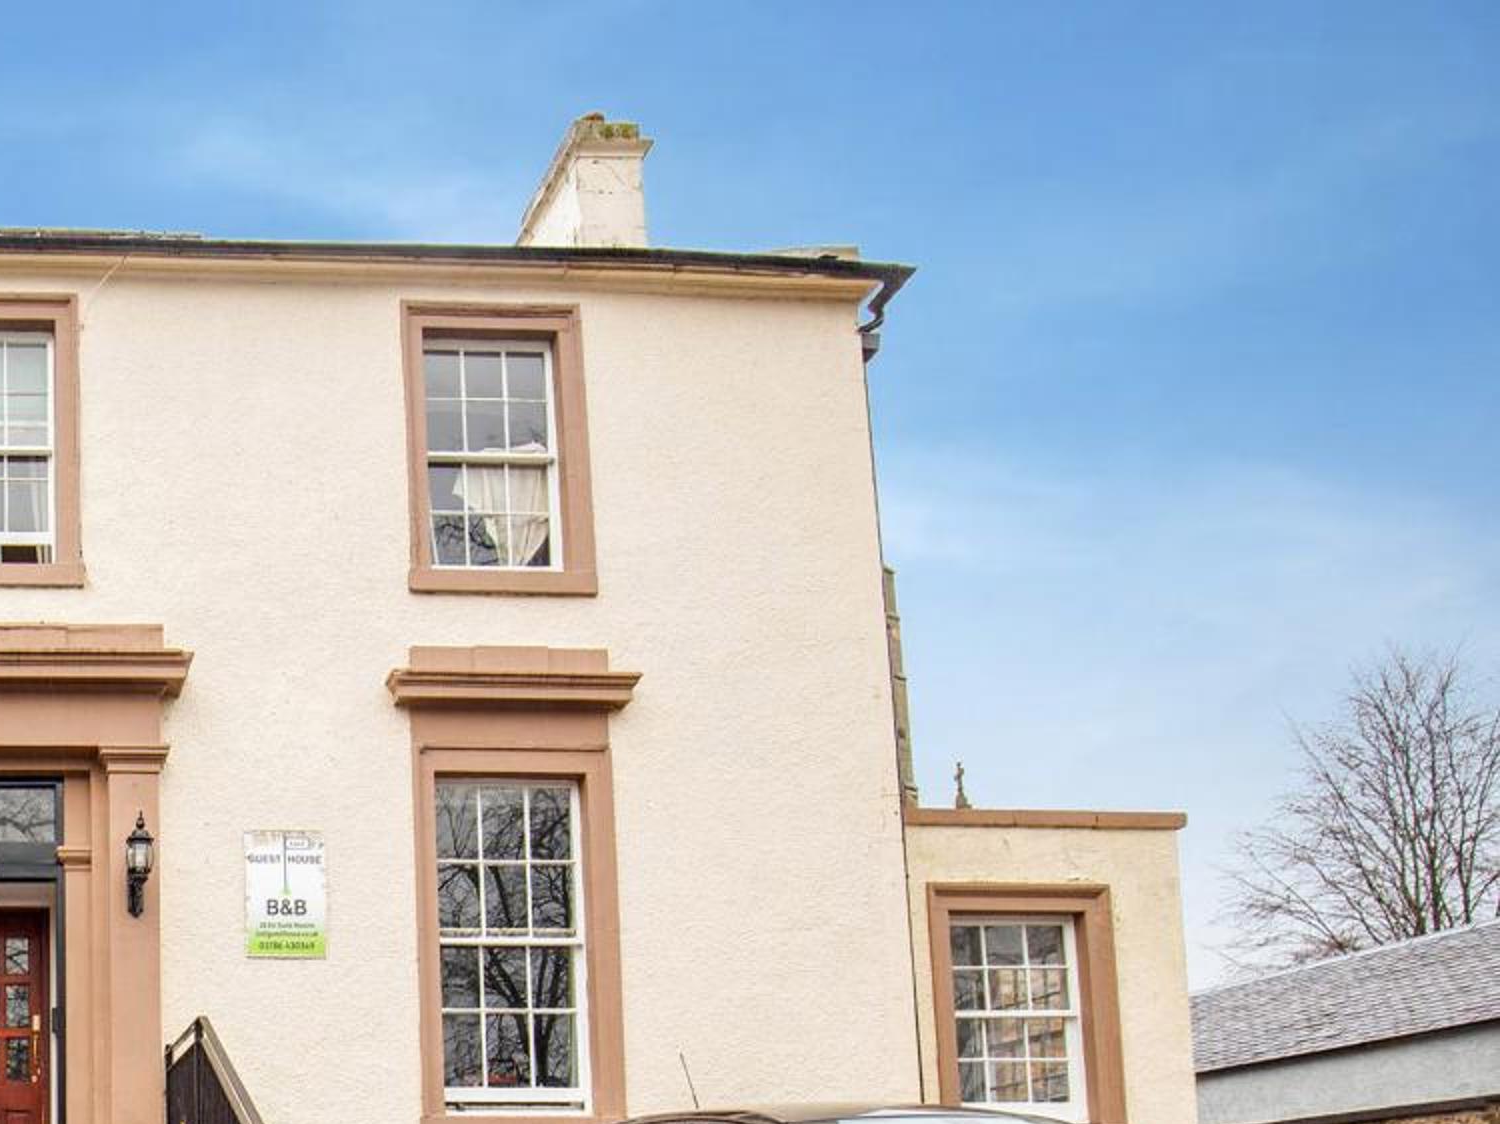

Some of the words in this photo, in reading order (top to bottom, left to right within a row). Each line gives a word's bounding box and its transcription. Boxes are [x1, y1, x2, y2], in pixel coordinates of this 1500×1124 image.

[246, 854, 281, 864] GUEST
[288, 855, 323, 864] HOUSE
[267, 899, 307, 915] B&B
